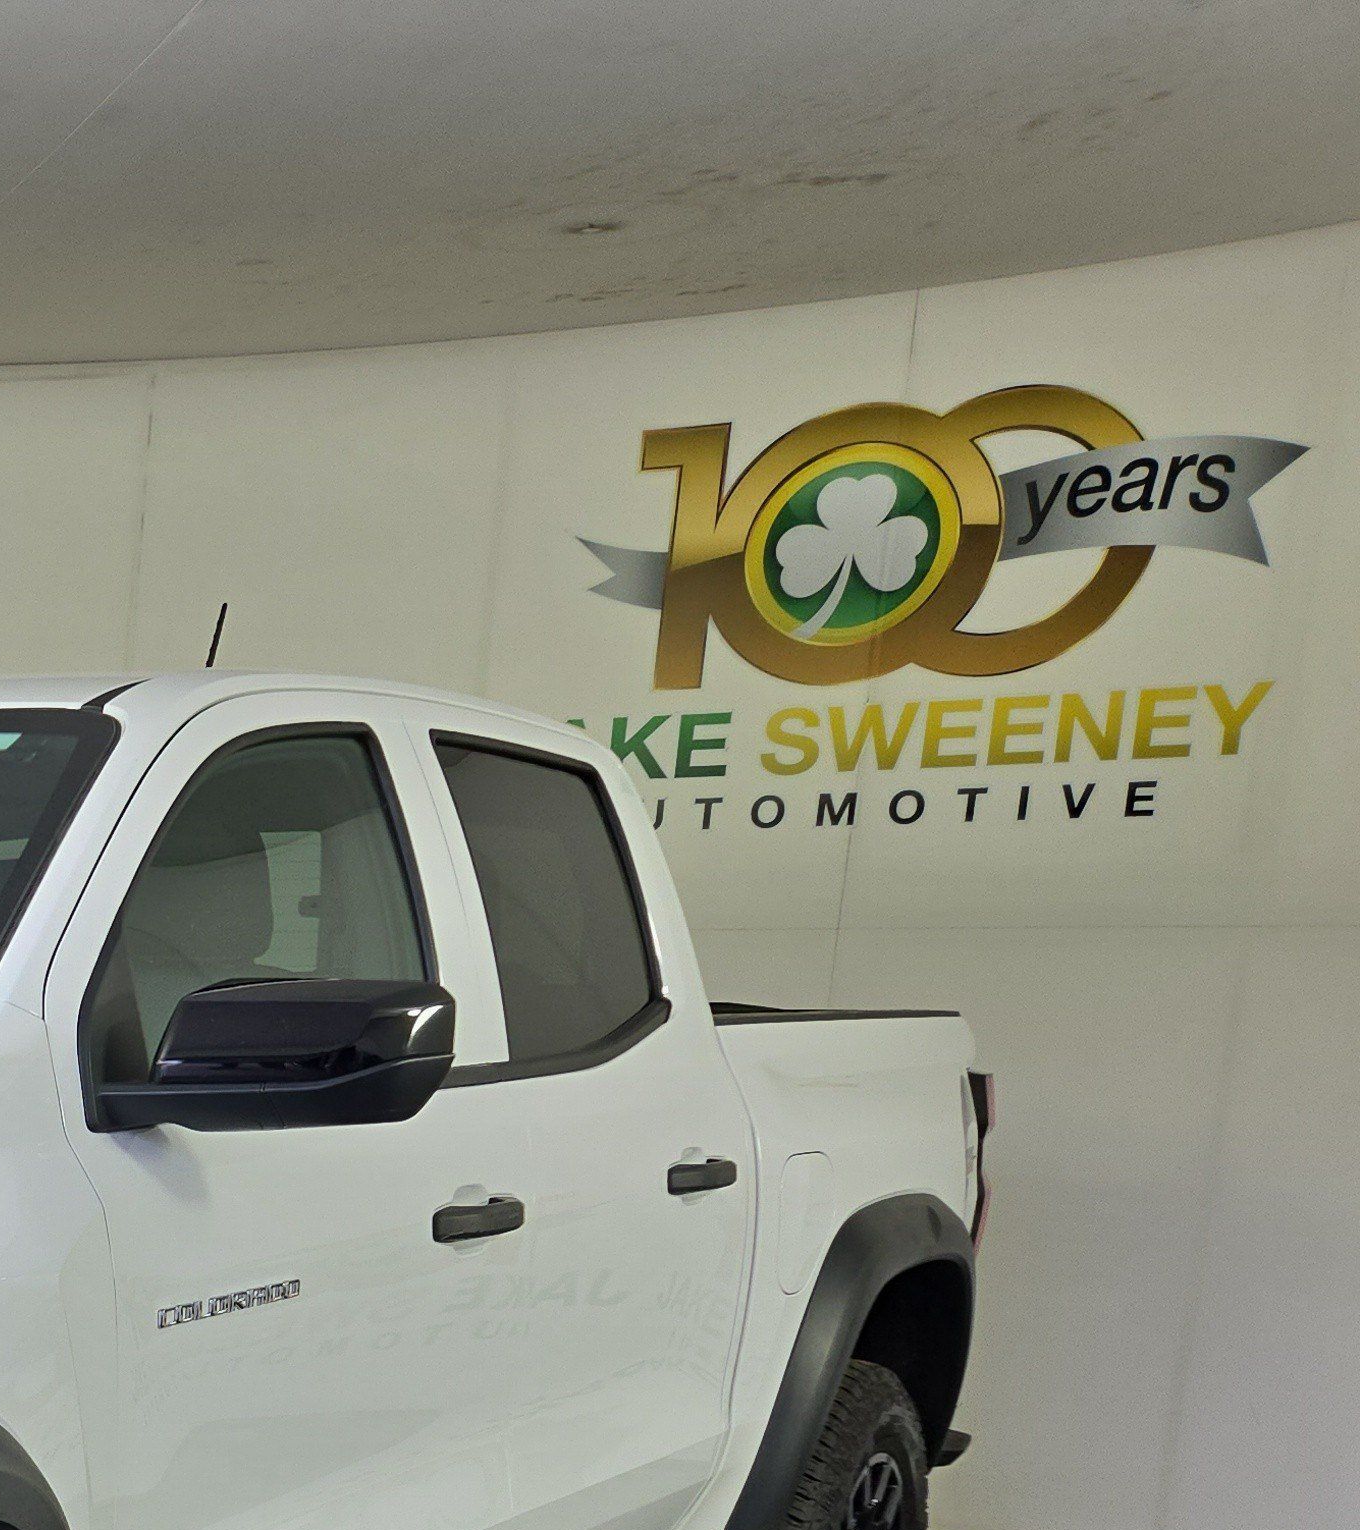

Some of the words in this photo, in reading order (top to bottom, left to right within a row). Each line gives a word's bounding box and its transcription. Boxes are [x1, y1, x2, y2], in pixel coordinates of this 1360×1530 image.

[639, 383, 1158, 691] 100
[1015, 451, 1237, 545] years
[567, 711, 734, 780] KE
[759, 679, 1276, 777] SWEENEY
[653, 779, 1159, 830] TOMOTIVE
[157, 1279, 301, 1329] COLORADO
